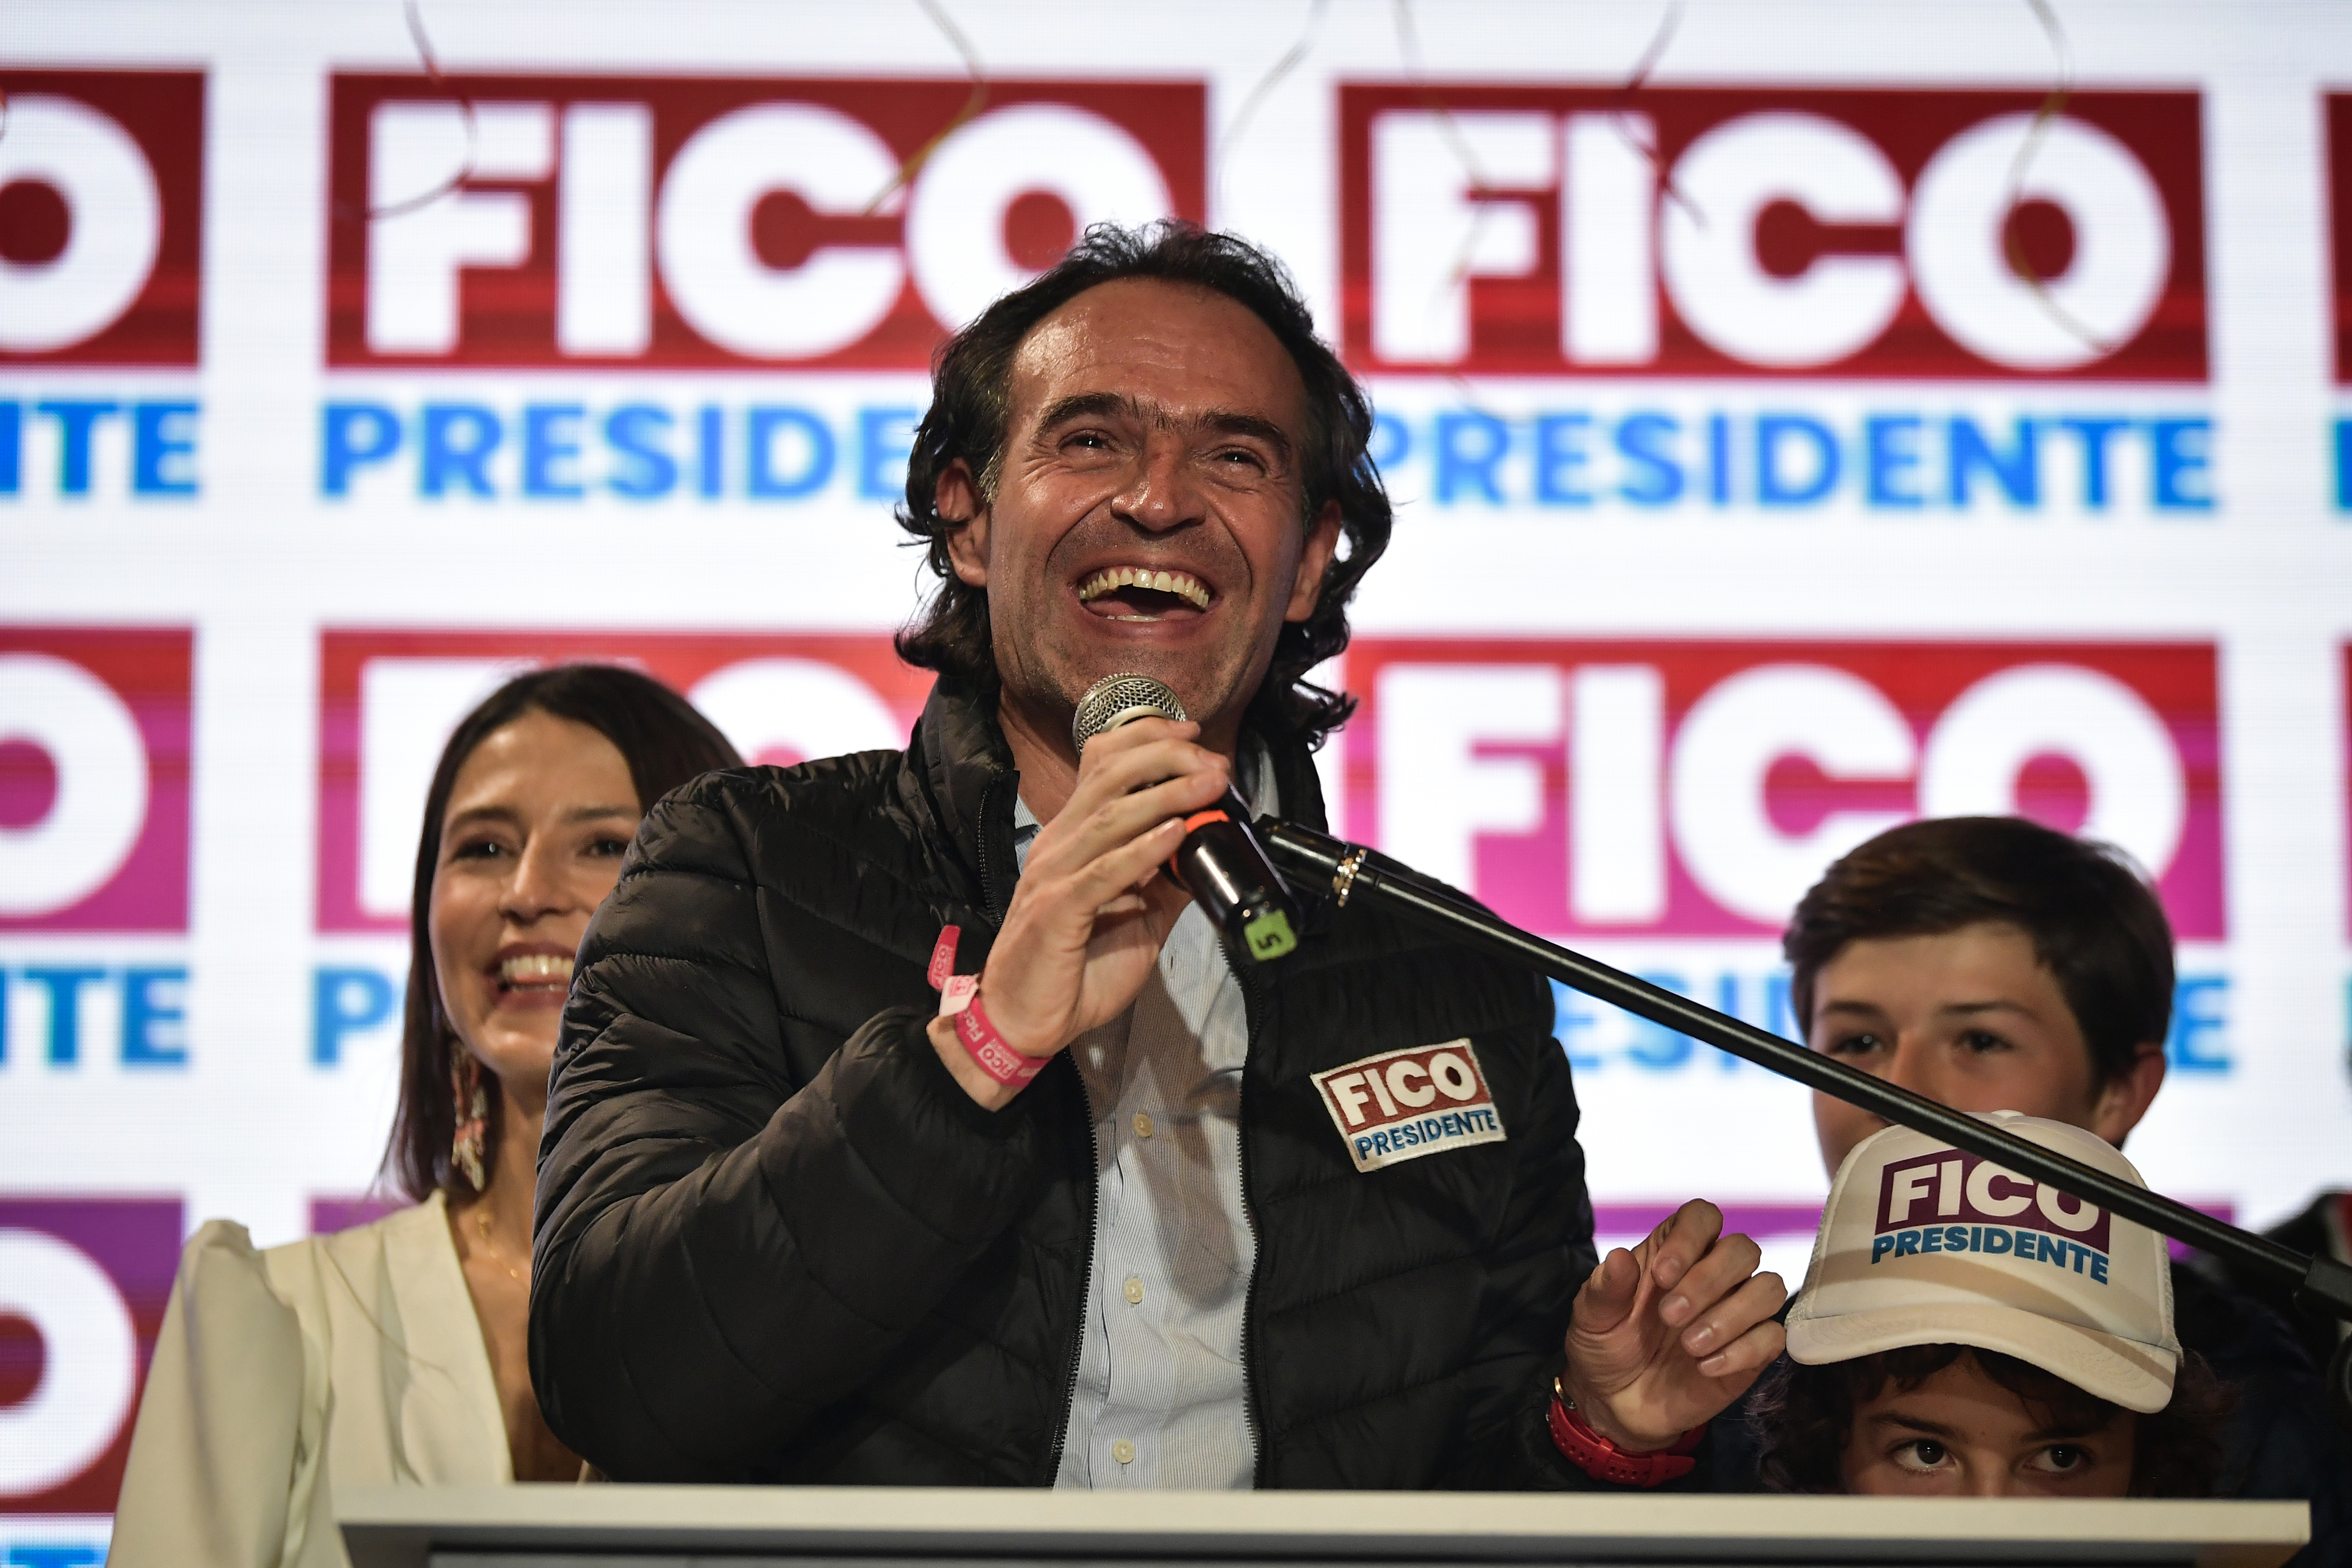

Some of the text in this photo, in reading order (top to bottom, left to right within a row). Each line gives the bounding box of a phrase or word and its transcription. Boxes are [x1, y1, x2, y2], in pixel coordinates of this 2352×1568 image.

[368, 101, 1176, 359] FICO
[1370, 111, 2171, 370] FICO
[0, 400, 199, 495] TE
[320, 402, 916, 500] PRESIDE
[1376, 662, 2186, 924] FICO
[0, 968, 186, 1064] TE
[1328, 1052, 1477, 1126] FICO
[1355, 1109, 1498, 1160] PRESIDENTE
[1888, 1159, 2099, 1231] FICO
[1871, 1226, 2109, 1285] PRESIDENTE
